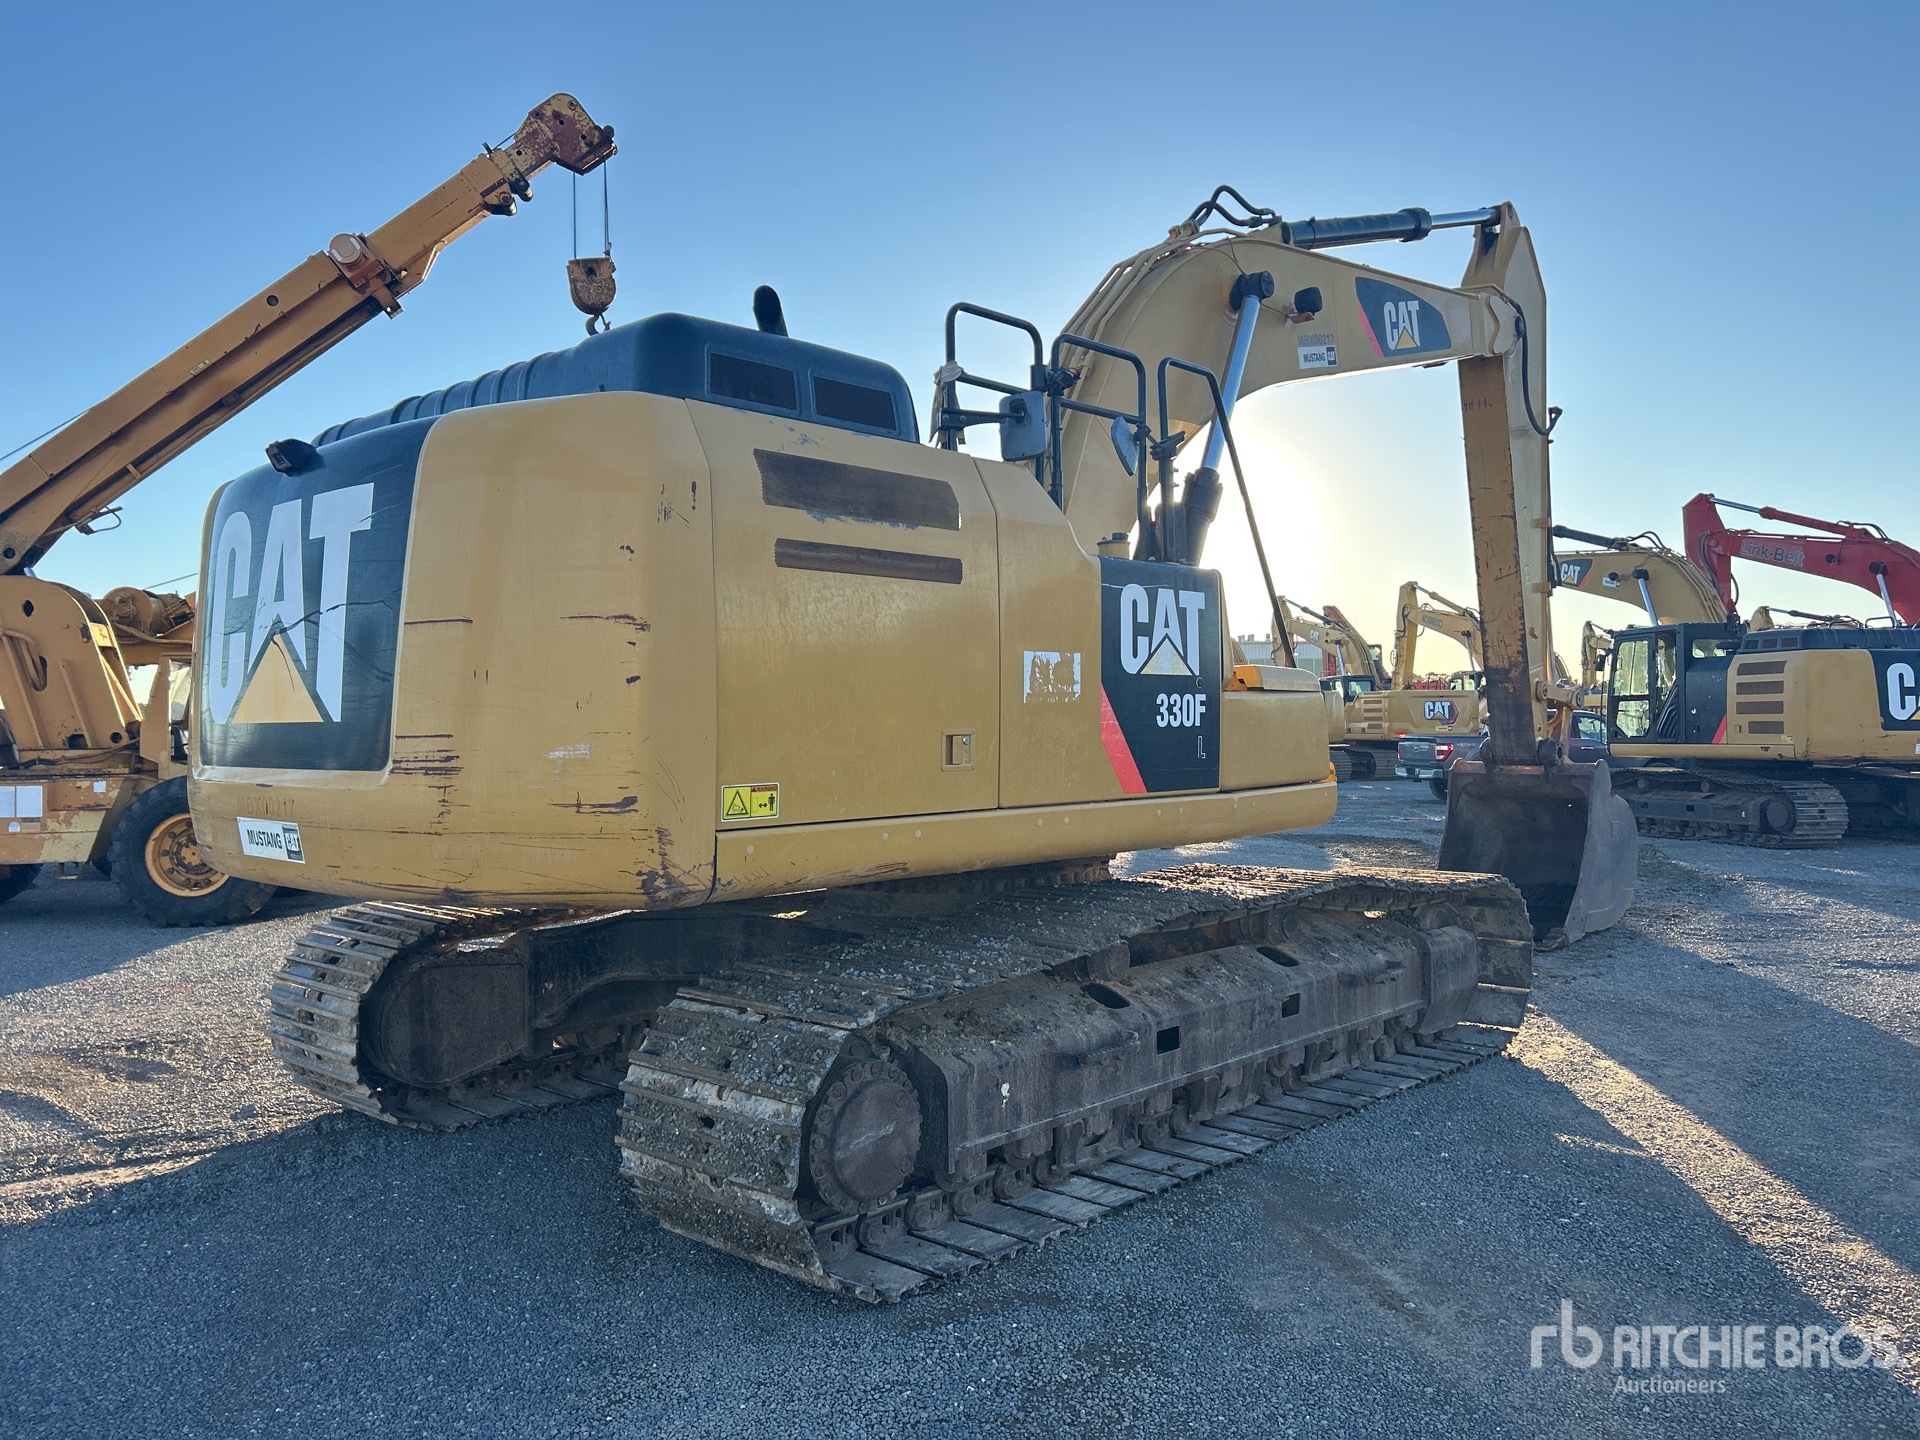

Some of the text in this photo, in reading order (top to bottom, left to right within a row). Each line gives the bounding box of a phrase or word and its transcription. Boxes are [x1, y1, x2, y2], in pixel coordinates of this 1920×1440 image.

[1383, 300, 1420, 350] CAT
[1303, 352, 1326, 363] MUSTANG
[1561, 563, 1580, 585] CAT
[208, 482, 375, 725] CAT
[1120, 583, 1206, 676] CAT
[1886, 662, 1920, 720] C
[1156, 693, 1206, 727] 330F
[1424, 701, 1451, 720] CAT
[246, 828, 283, 850] MUSTANG
